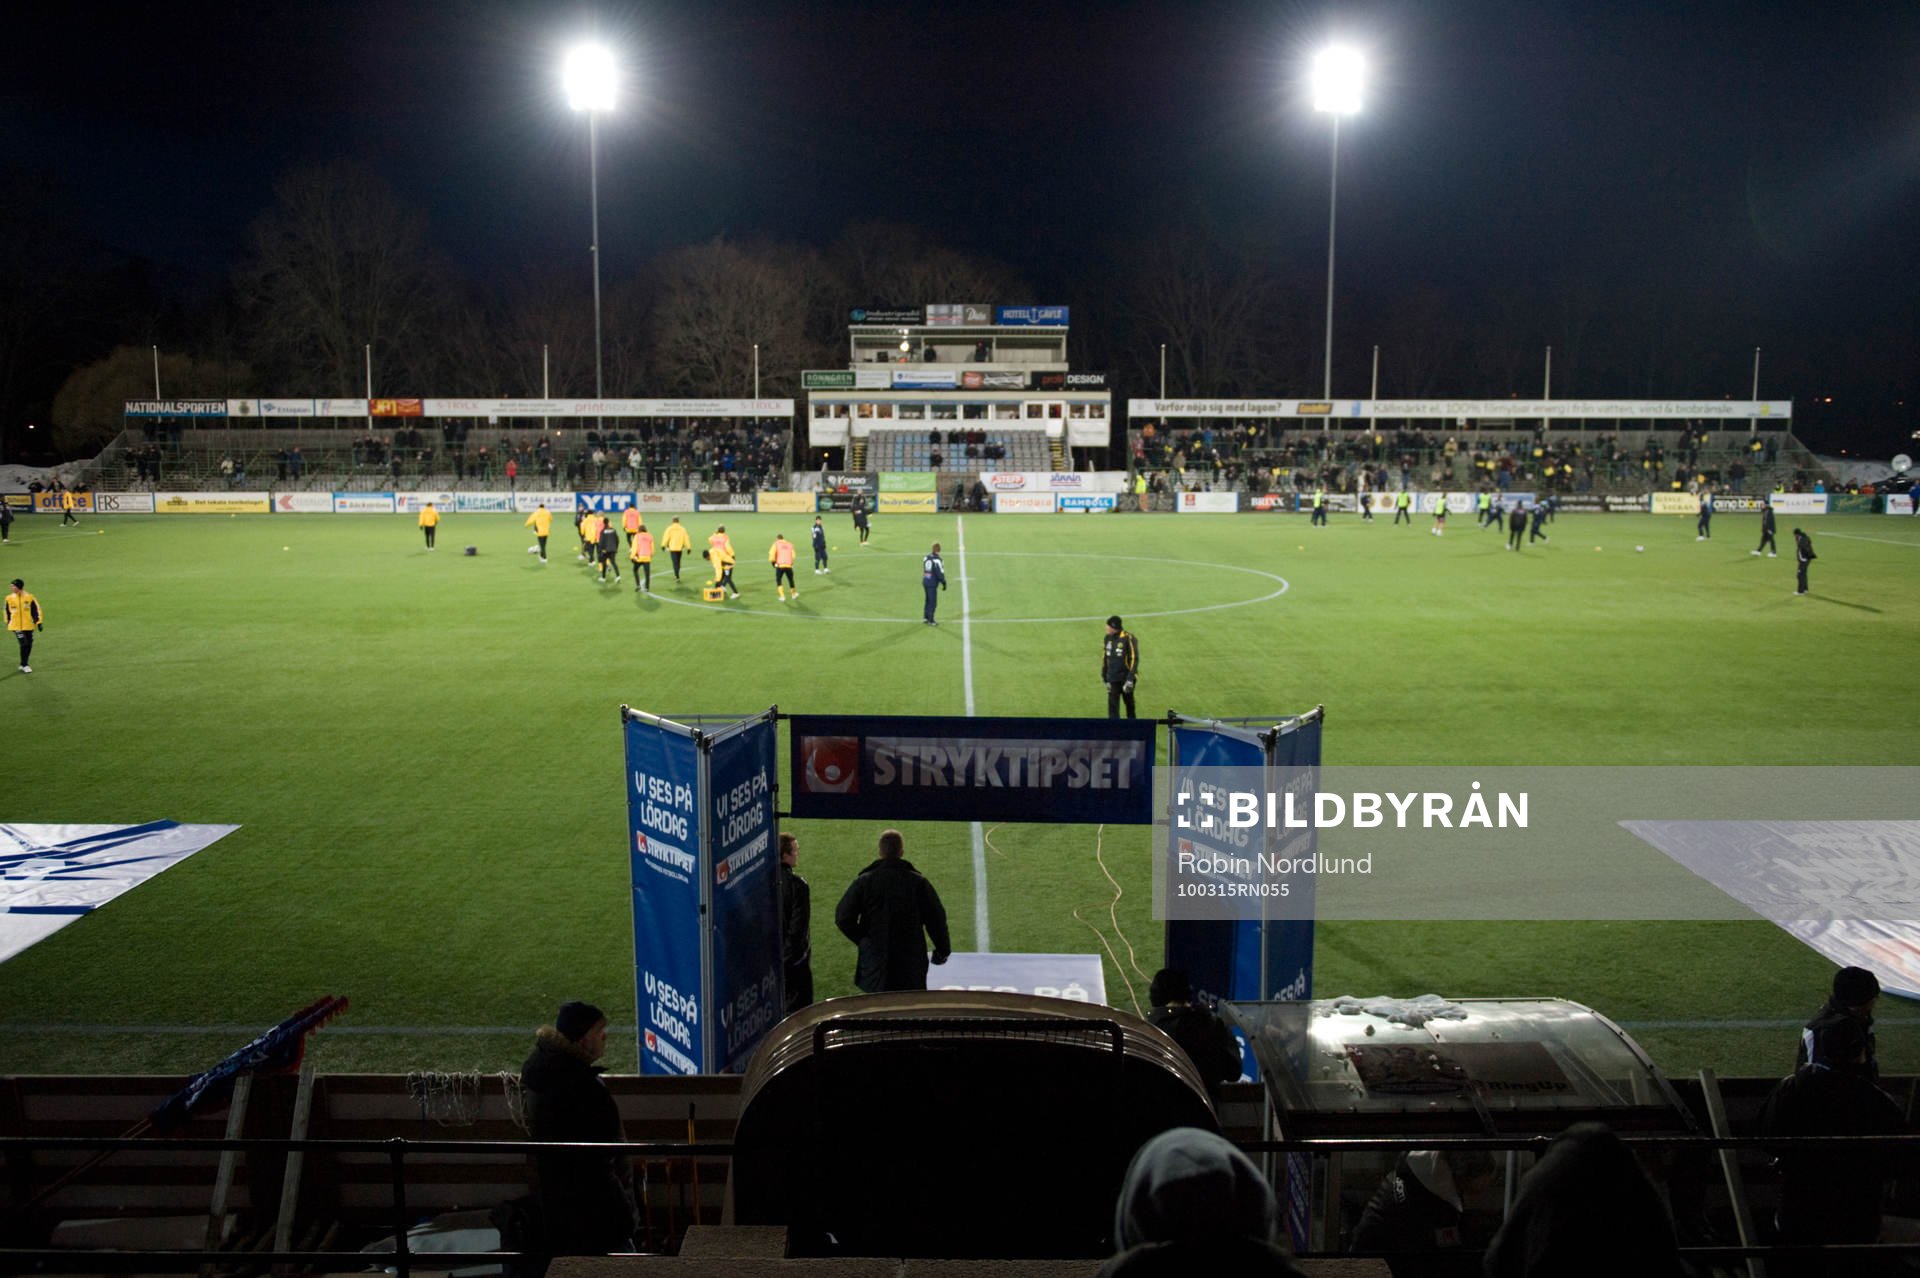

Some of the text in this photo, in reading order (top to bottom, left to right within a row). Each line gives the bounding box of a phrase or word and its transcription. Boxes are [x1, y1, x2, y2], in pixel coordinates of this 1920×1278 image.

[1067, 375, 1105, 384] DESIGN
[125, 402, 226, 413] NATIONALSPORTEN
[1155, 402, 1282, 414] Varför nöja sig med lagom?
[42, 494, 87, 507] offe
[97, 494, 120, 511] ERS
[581, 495, 632, 510] YIT
[1251, 497, 1285, 506] BRIXX
[873, 746, 1137, 789] STRYKTIPSET
[635, 770, 693, 814] VI SES PÅ
[717, 765, 768, 819] VI SES PÅ
[641, 801, 688, 841] LÖRDAG
[722, 802, 763, 847] LÖRDAG
[647, 836, 695, 873] STRYKTIPSET
[728, 829, 769, 873] STRYKTIPSET
[644, 971, 698, 1025] VI SES PÅ
[650, 1001, 691, 1050] LÖRDAG
